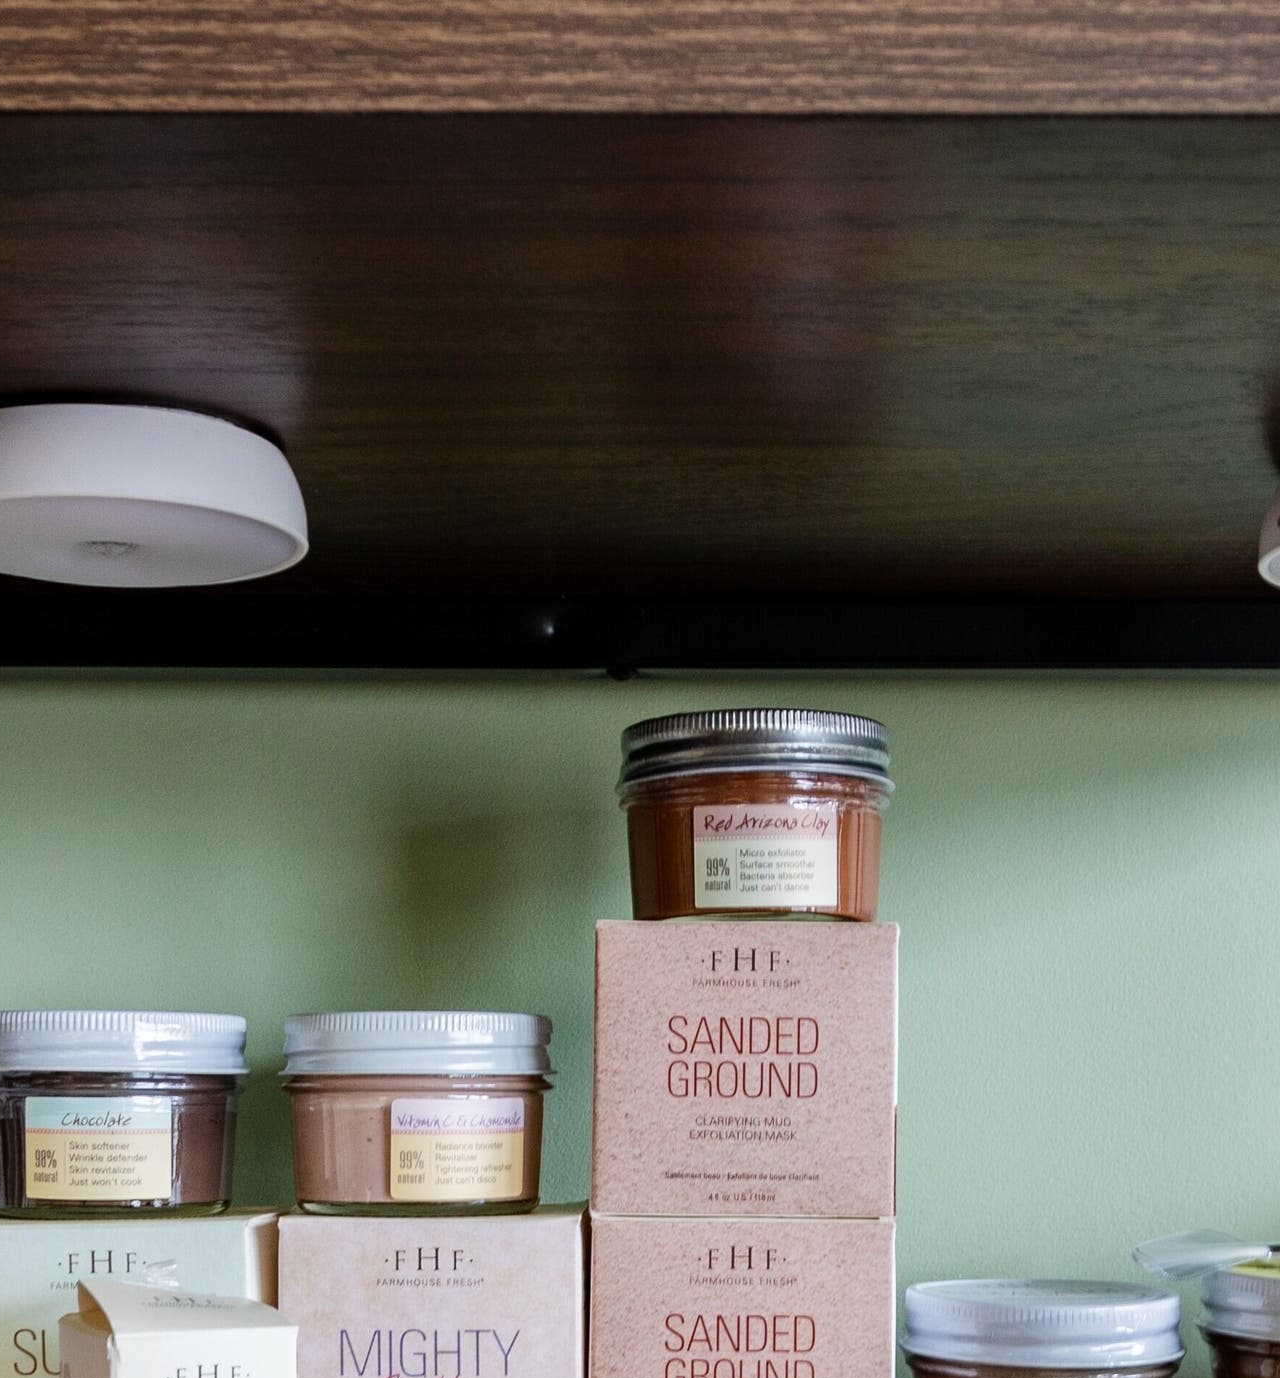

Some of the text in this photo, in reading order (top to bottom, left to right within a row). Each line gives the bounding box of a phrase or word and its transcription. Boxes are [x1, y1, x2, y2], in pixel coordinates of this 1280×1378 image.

[704, 812, 830, 838] Red Arizona Clay
[740, 849, 806, 858] Micro exfoliator
[706, 858, 730, 877] 99%
[740, 861, 773, 869] Surface
[740, 872, 813, 881] Bacteria absorber
[705, 880, 731, 891] natural
[740, 883, 758, 892] Just
[785, 883, 809, 892] dance
[692, 978, 758, 988] FARMHOUSE
[668, 1016, 820, 1056] SANDED
[668, 1060, 819, 1099] GROUND
[61, 1111, 133, 1127] Chocolate
[398, 1112, 521, 1128] Vitamin C Chamomile
[695, 1116, 792, 1128] CLARIFYING MUD
[690, 1130, 797, 1141] EXFOLIATION MASK
[69, 1141, 130, 1150] Skin softener
[435, 1141, 504, 1151] Radiance booster
[69, 1153, 148, 1162] Wrinkle defender
[399, 1149, 424, 1170] 99%
[435, 1153, 477, 1162] Revitalizer
[69, 1165, 137, 1174] Skin revitalizer
[435, 1163, 512, 1174] Tightening refresher
[33, 1171, 58, 1183] natural
[69, 1176, 143, 1187] Just won't cook
[397, 1173, 425, 1184] natural
[434, 1175, 453, 1185] Just
[477, 1175, 497, 1184] disco
[377, 1278, 442, 1287] FARMHOUSE
[690, 1276, 754, 1286] FARMHOUSE
[664, 1314, 816, 1352] SANDED
[340, 1329, 520, 1378] MIGHTY
